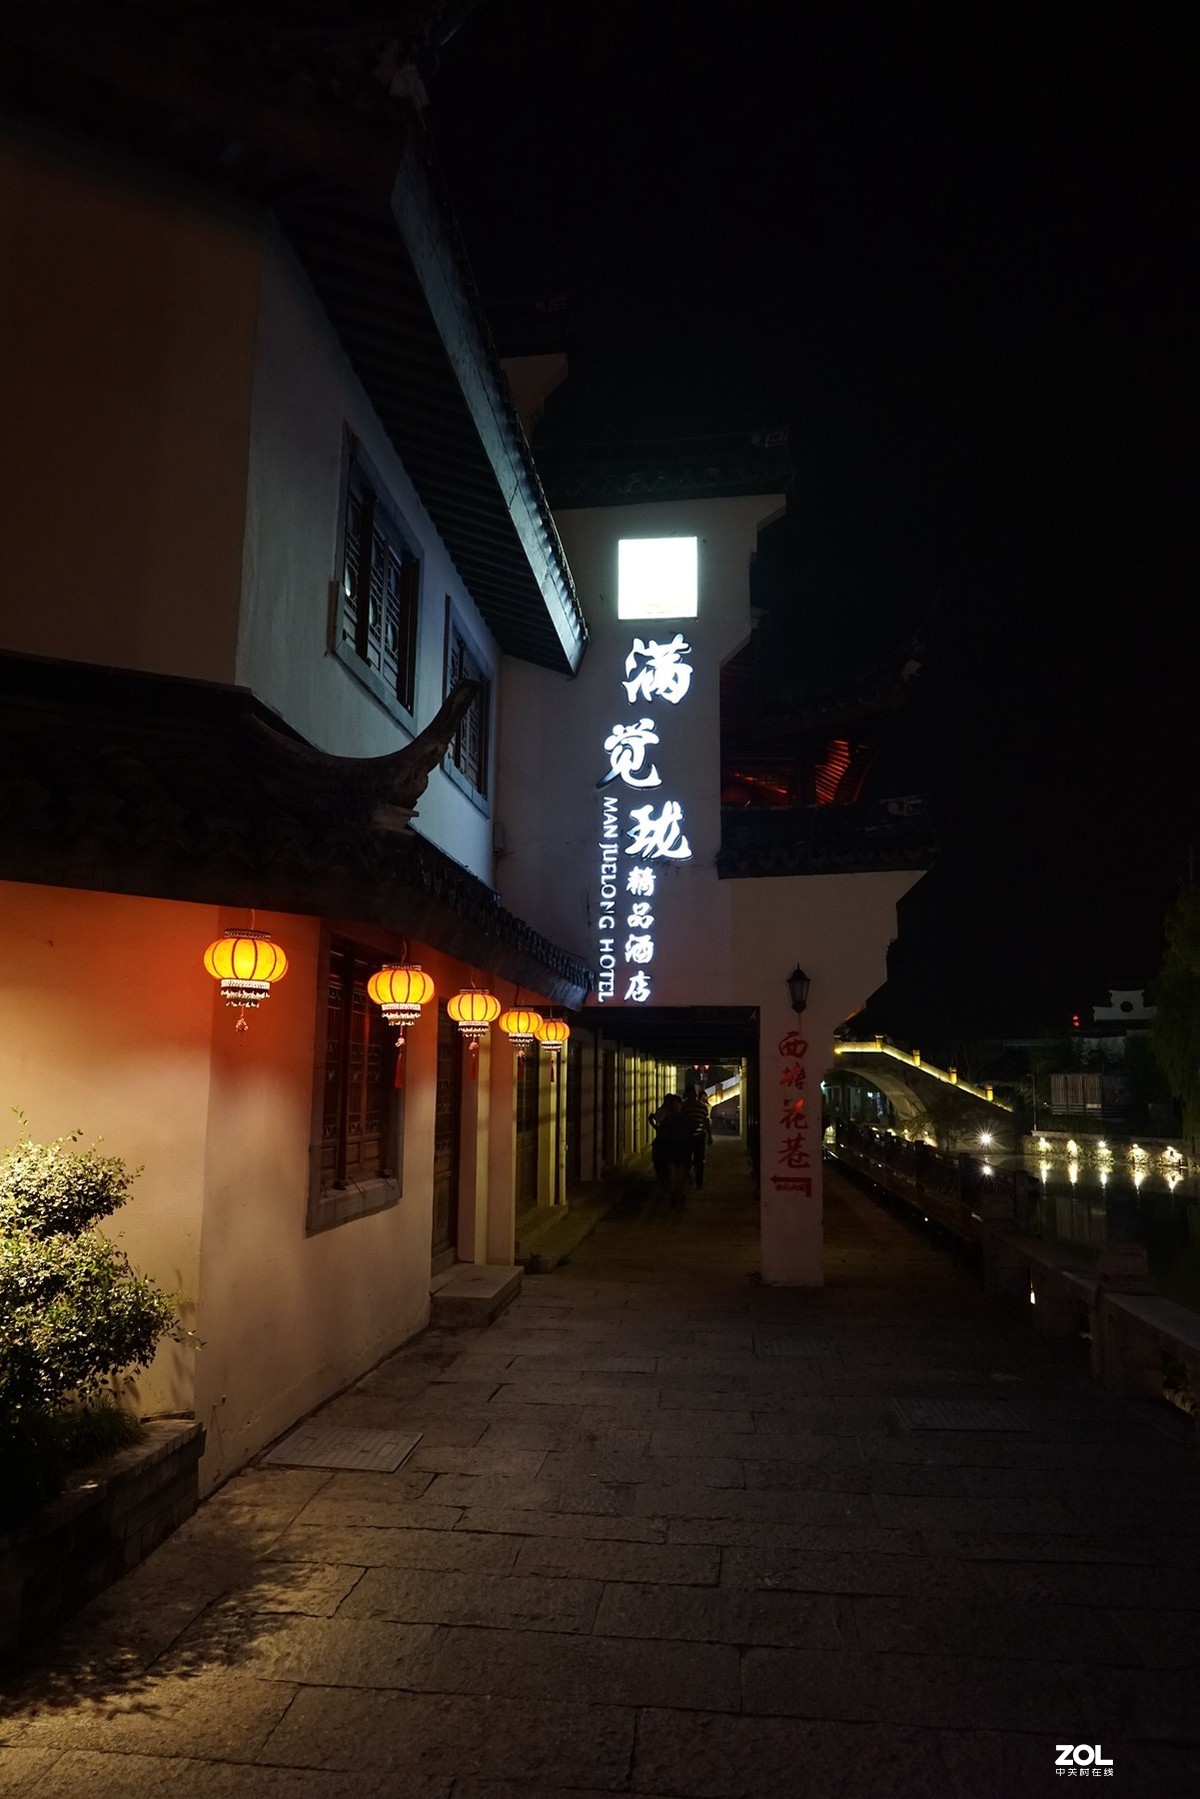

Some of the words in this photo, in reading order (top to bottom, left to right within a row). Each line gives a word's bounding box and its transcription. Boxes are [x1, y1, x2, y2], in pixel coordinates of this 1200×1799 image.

[602, 796, 619, 838] MAN
[598, 842, 619, 929] JUELONG
[598, 938, 616, 1003] HOTEL
[624, 865, 657, 1003] 精品酒店
[778, 1030, 811, 1169] 西塘花巷
